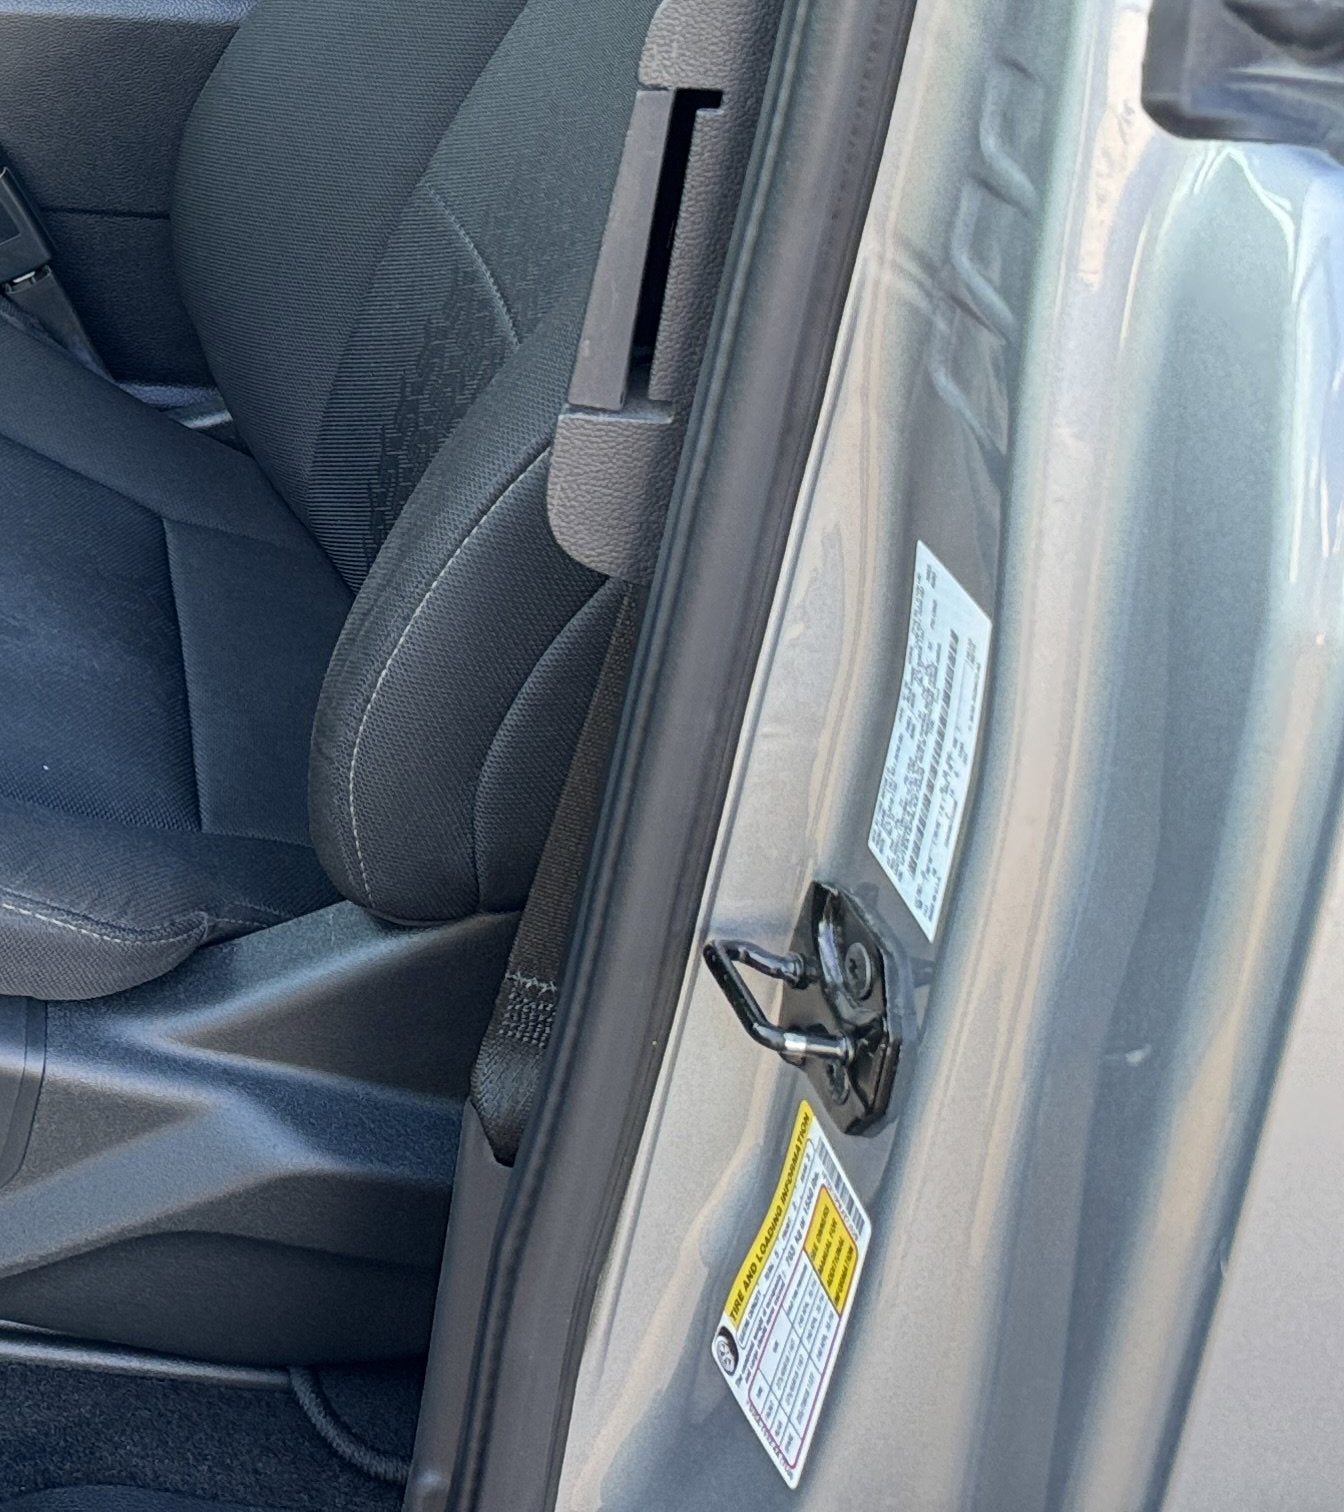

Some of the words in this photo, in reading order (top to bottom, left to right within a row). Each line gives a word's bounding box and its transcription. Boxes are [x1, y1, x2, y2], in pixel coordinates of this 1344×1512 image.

[729, 1287, 744, 1323] TIRE
[742, 1258, 757, 1292] AND
[755, 1203, 782, 1264] LOADING
[780, 1110, 809, 1205] INFORMATION
